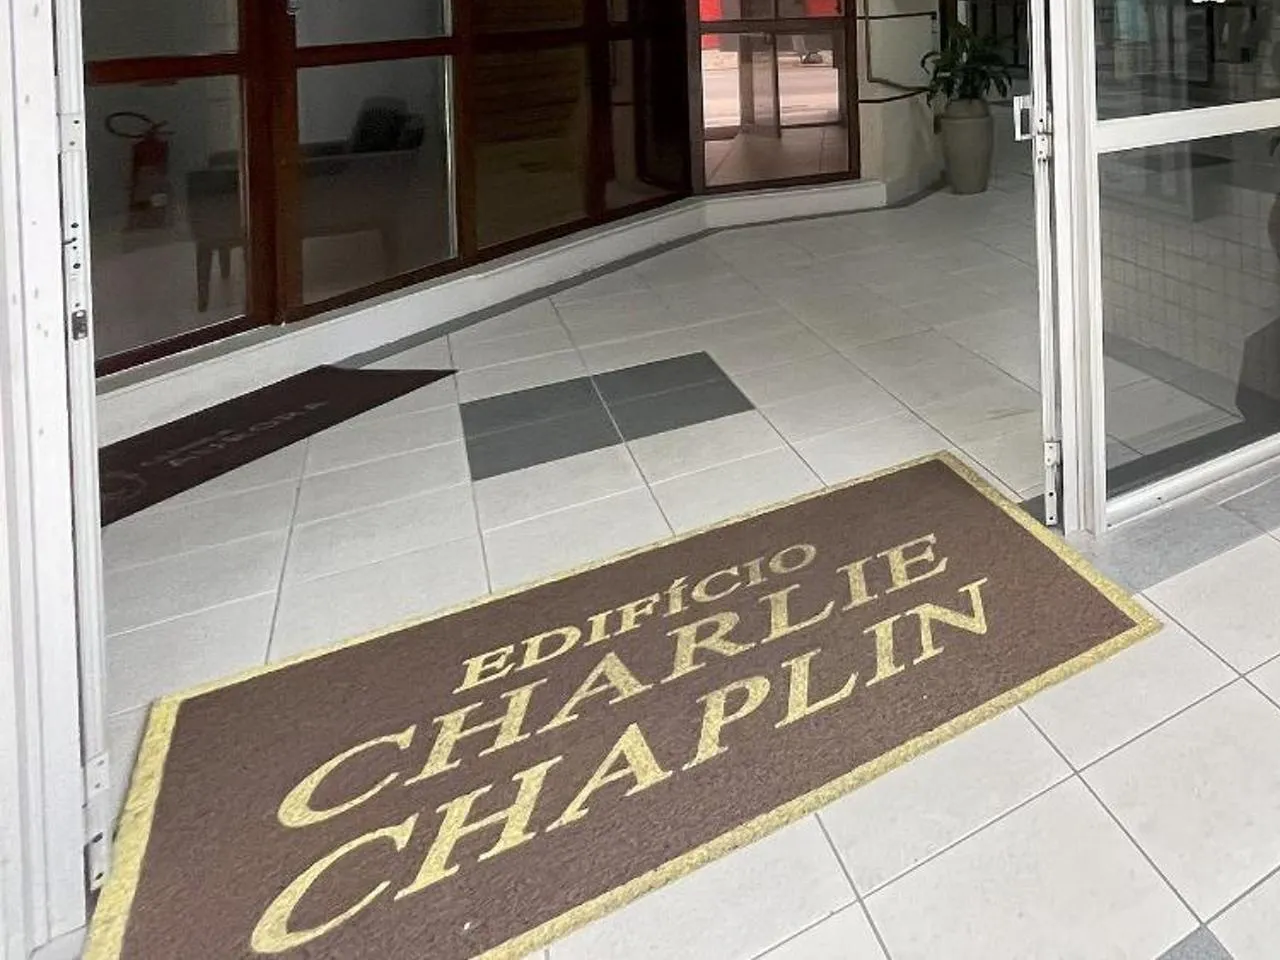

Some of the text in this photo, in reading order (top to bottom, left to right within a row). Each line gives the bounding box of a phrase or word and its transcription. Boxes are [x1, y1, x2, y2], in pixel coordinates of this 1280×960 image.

[248, 577, 991, 954] CHAPLIN
[277, 533, 949, 828] CHARLIE
[452, 543, 818, 693] EDIFÍCIO
